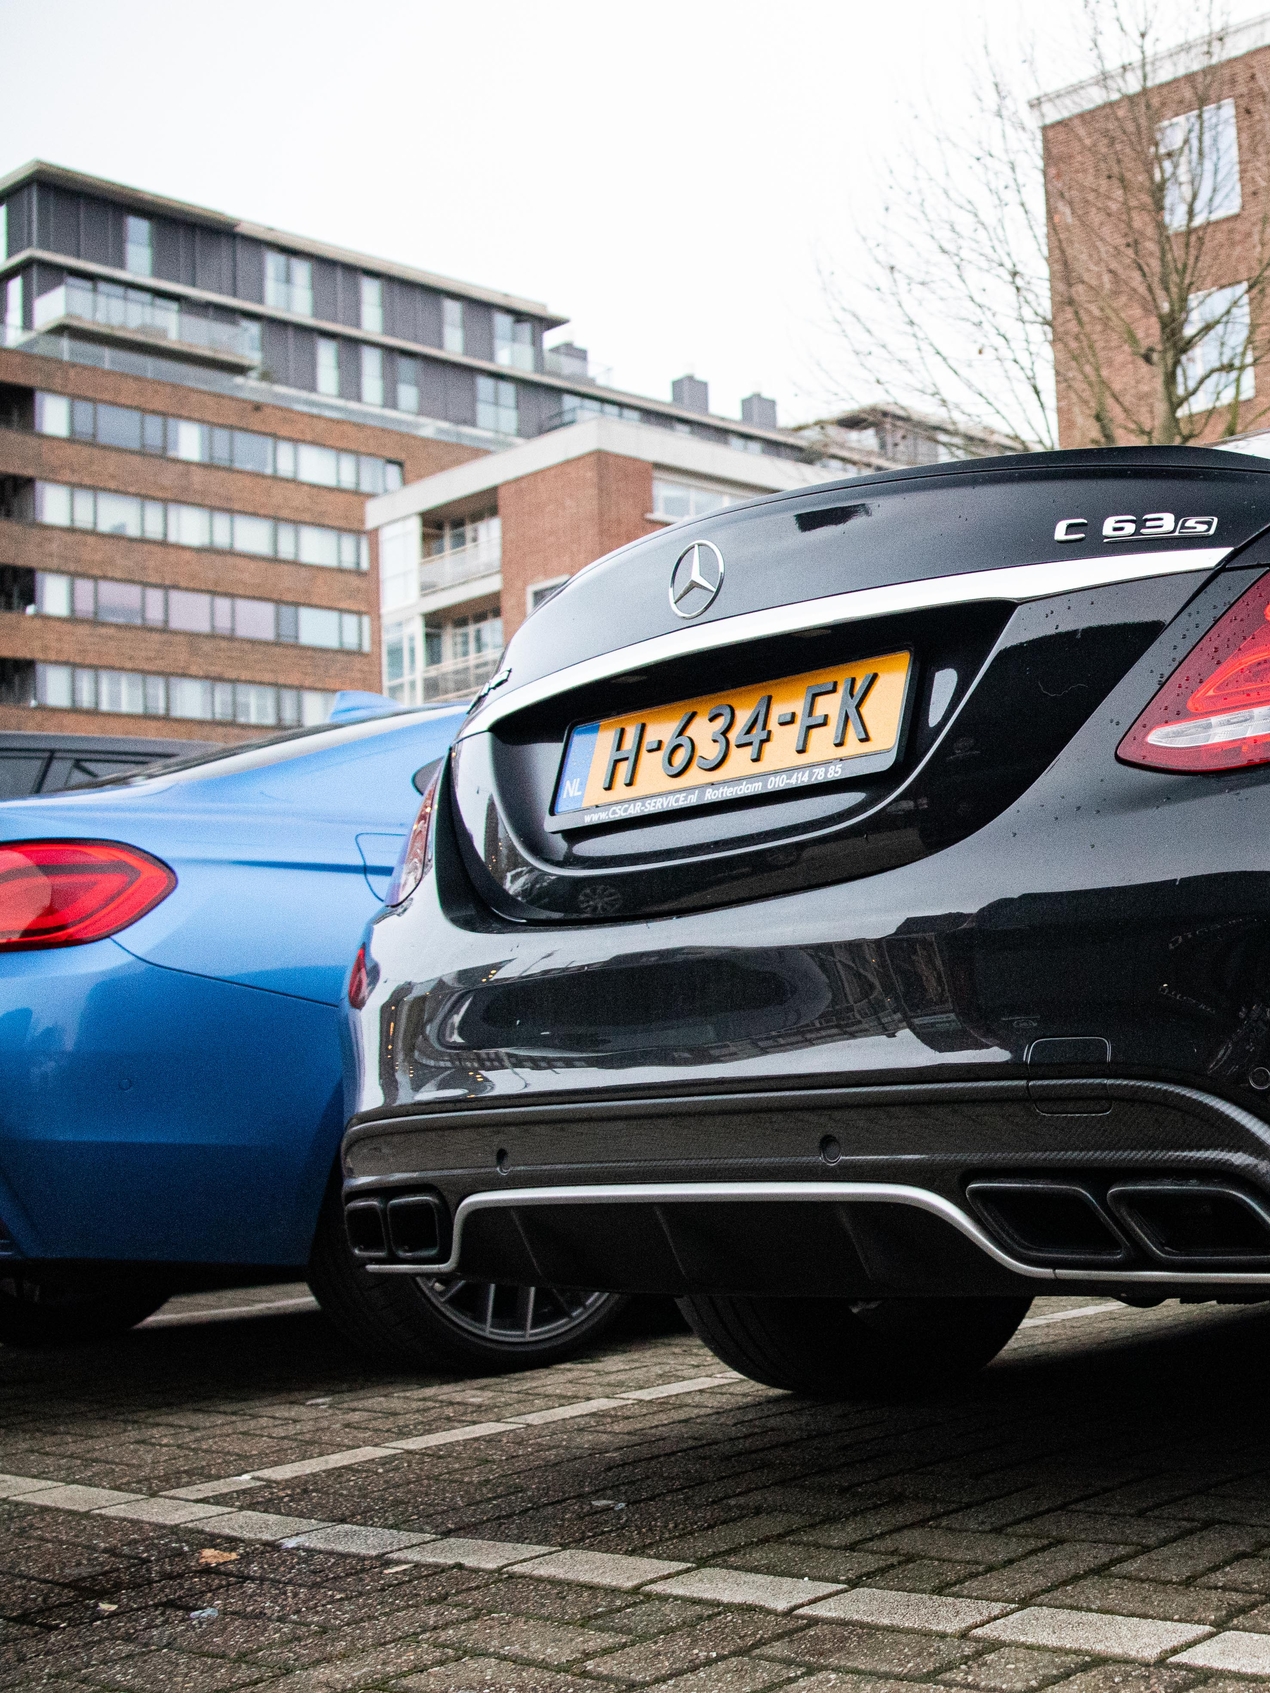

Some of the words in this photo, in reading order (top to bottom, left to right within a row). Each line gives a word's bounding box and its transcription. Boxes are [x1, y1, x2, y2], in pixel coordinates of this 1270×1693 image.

[1054, 518, 1088, 542] C
[602, 672, 879, 792] H-634-FK
[563, 778, 583, 798] NL
[584, 790, 698, 824] www.CSCAR-SERVICE.nl
[704, 780, 763, 802] Rotterdam
[767, 769, 810, 789] 010-414
[811, 766, 825, 783] 78
[827, 763, 842, 780] 85
